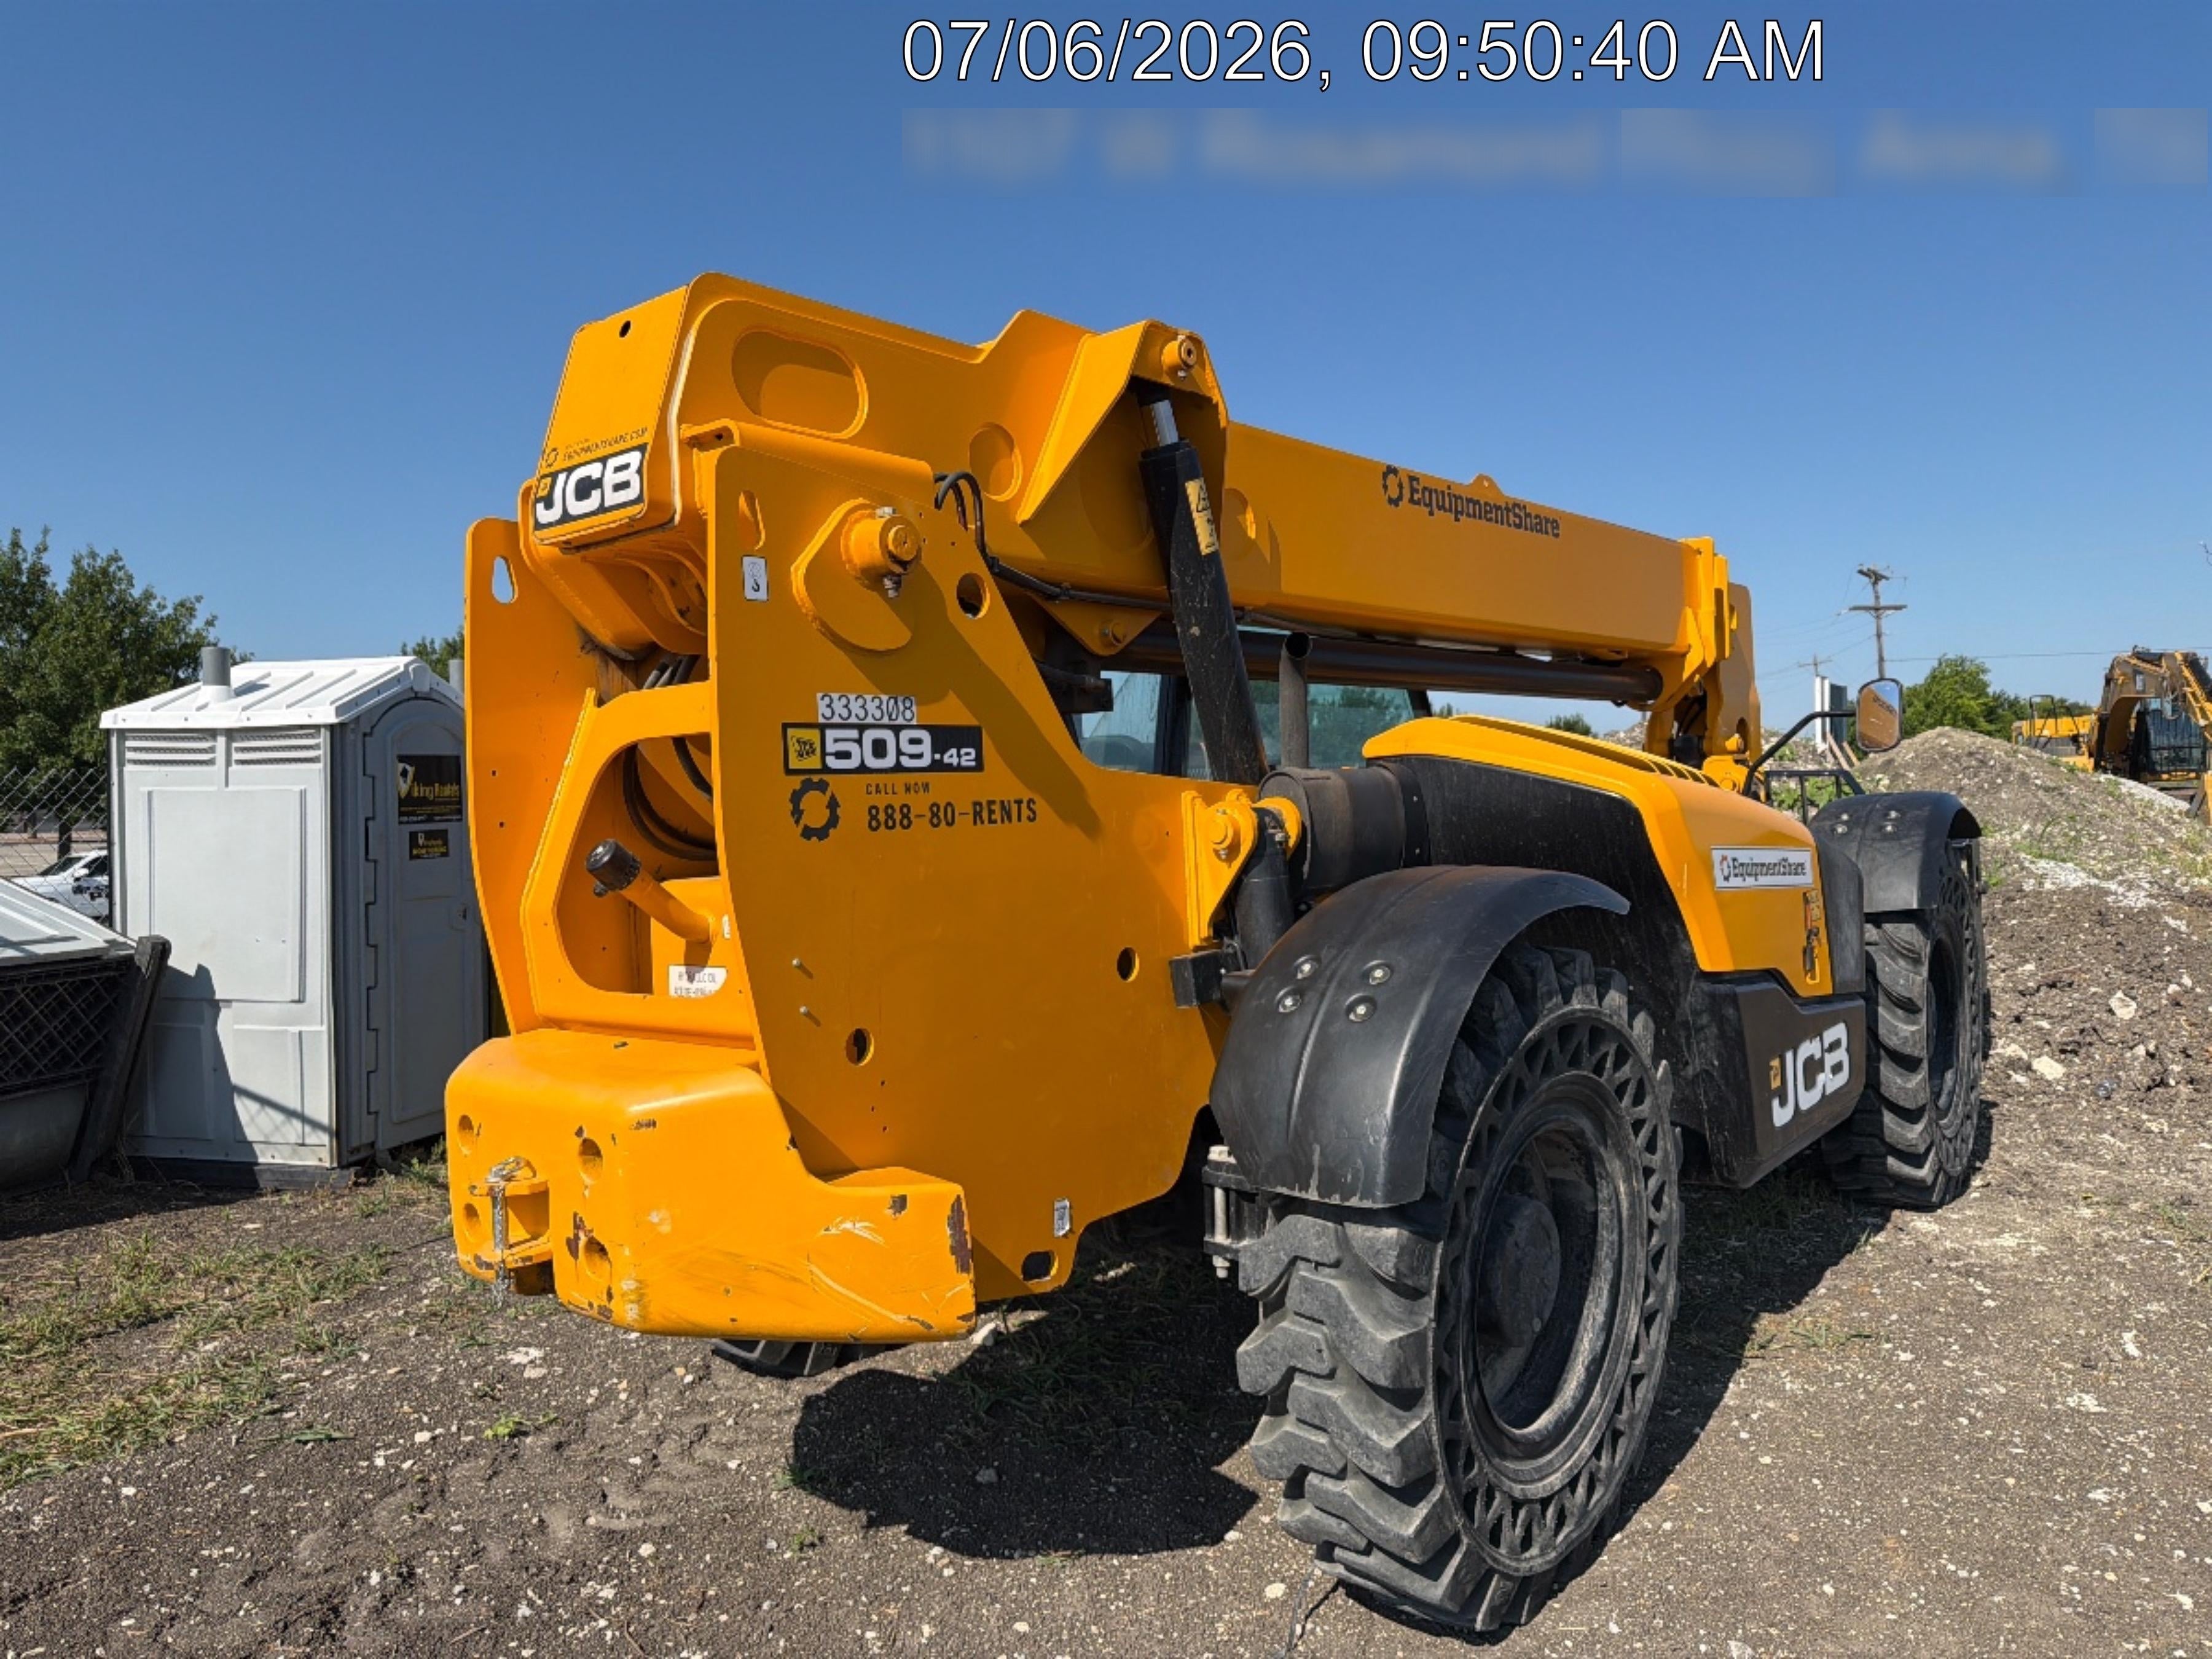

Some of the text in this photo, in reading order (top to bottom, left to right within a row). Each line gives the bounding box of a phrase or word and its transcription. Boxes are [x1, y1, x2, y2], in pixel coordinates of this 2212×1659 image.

[535, 450, 643, 525] JCB
[1408, 475, 1561, 538] EquipmentShare
[820, 694, 916, 722] 333308
[866, 782, 930, 795] CALL NOW
[868, 798, 1037, 832] 888-80-RENTS
[1771, 1022, 1851, 1128] JCB
